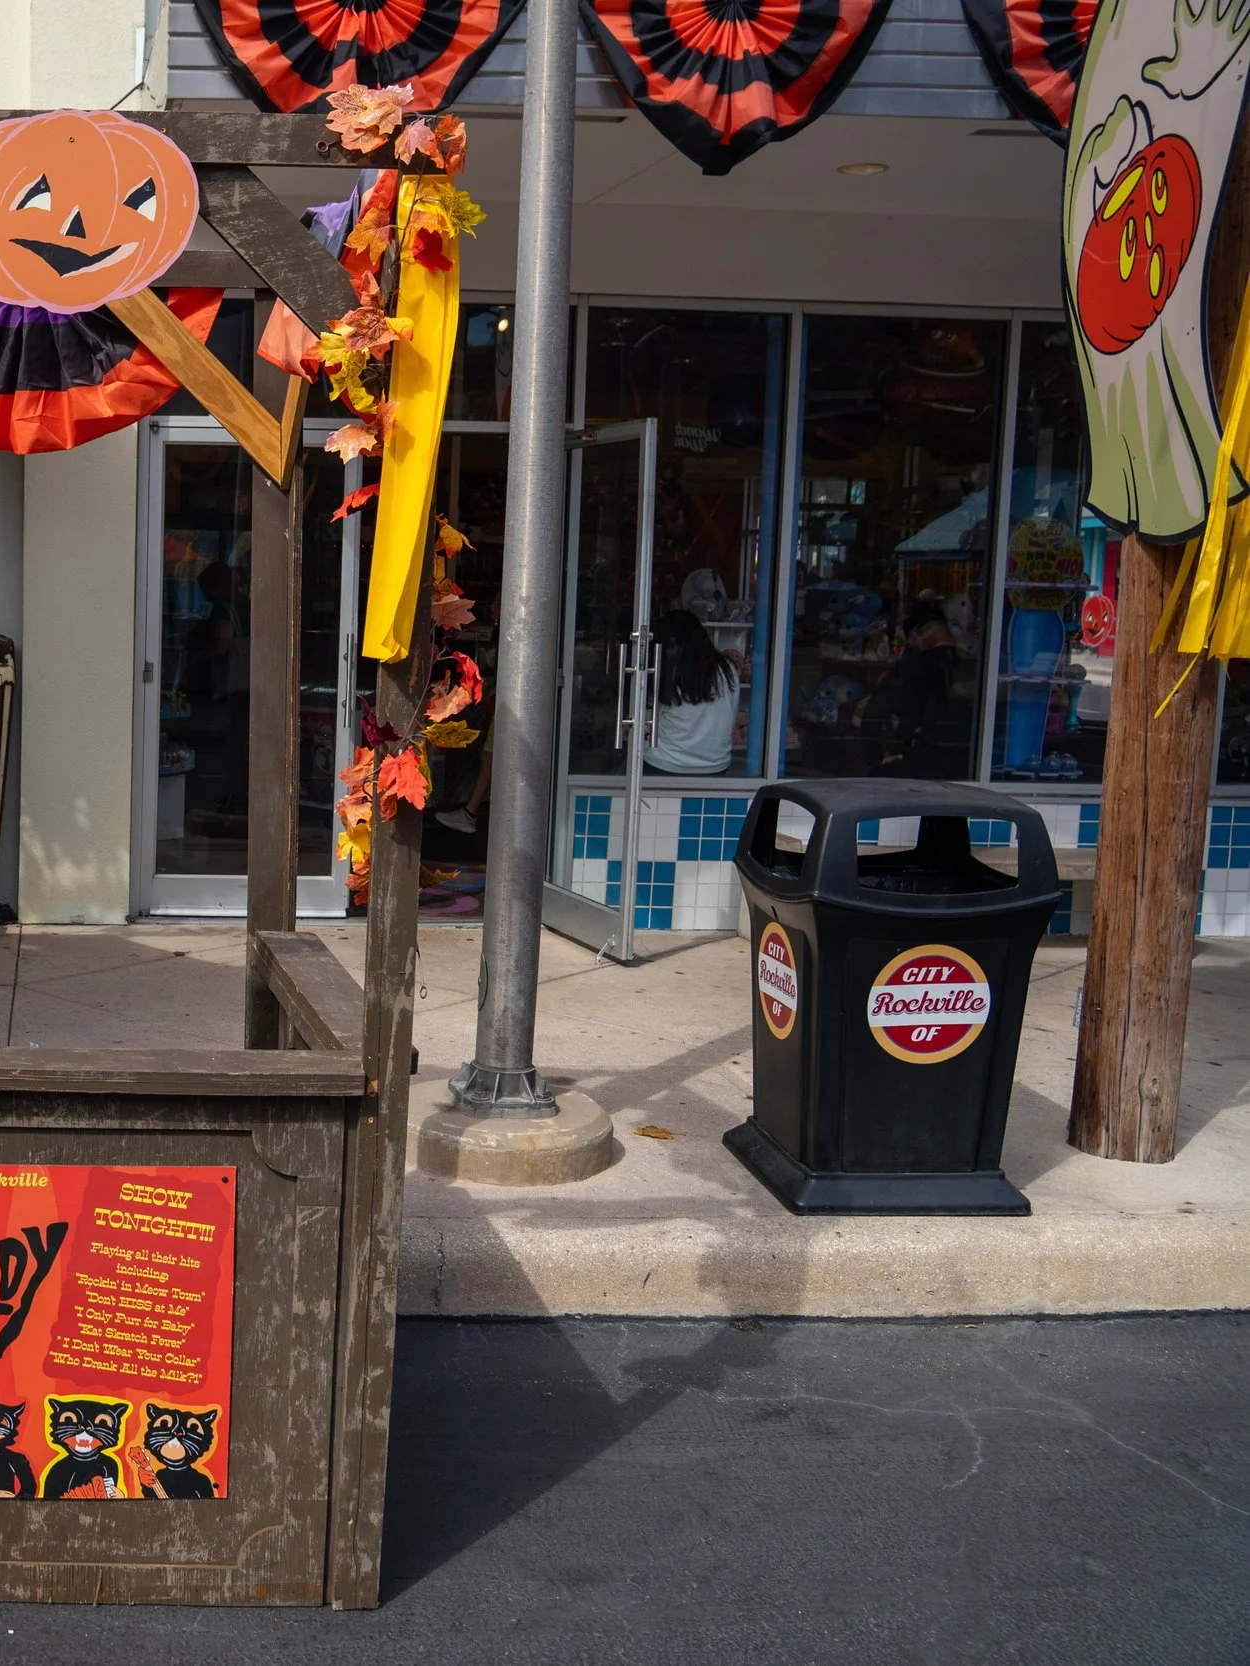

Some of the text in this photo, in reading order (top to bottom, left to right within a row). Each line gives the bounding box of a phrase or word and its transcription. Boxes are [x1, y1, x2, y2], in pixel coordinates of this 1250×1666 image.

[768, 941, 786, 961] CITY
[760, 960, 796, 999] Rockville
[902, 966, 956, 983] CITY
[772, 1000, 783, 1017] OF
[871, 989, 987, 1017] Rockville
[910, 1026, 942, 1042] OF
[119, 1182, 193, 1209] SHOW
[94, 1207, 216, 1242] TONIGHT!!!
[90, 1241, 201, 1269] Playing all their hits
[115, 1262, 169, 1283] including:
[121, 1280, 132, 1292] in
[134, 1282, 169, 1297] Meow
[171, 1287, 206, 1303] Town"
[118, 1296, 153, 1311] HISS
[154, 1303, 166, 1314] at
[167, 1303, 190, 1317] Me"
[85, 1307, 113, 1324] Only
[114, 1312, 142, 1326] Purr
[143, 1316, 159, 1329] for
[160, 1319, 195, 1336] Baby"
[104, 1327, 148, 1344] Skratch
[150, 1333, 186, 1349] Fever"
[71, 1338, 100, 1353] Don't
[103, 1343, 133, 1358] Wear
[135, 1348, 163, 1362] Your
[164, 1352, 201, 1367] Collar"
[82, 1356, 118, 1372] Drank
[120, 1362, 138, 1375] All
[140, 1365, 158, 1378] the
